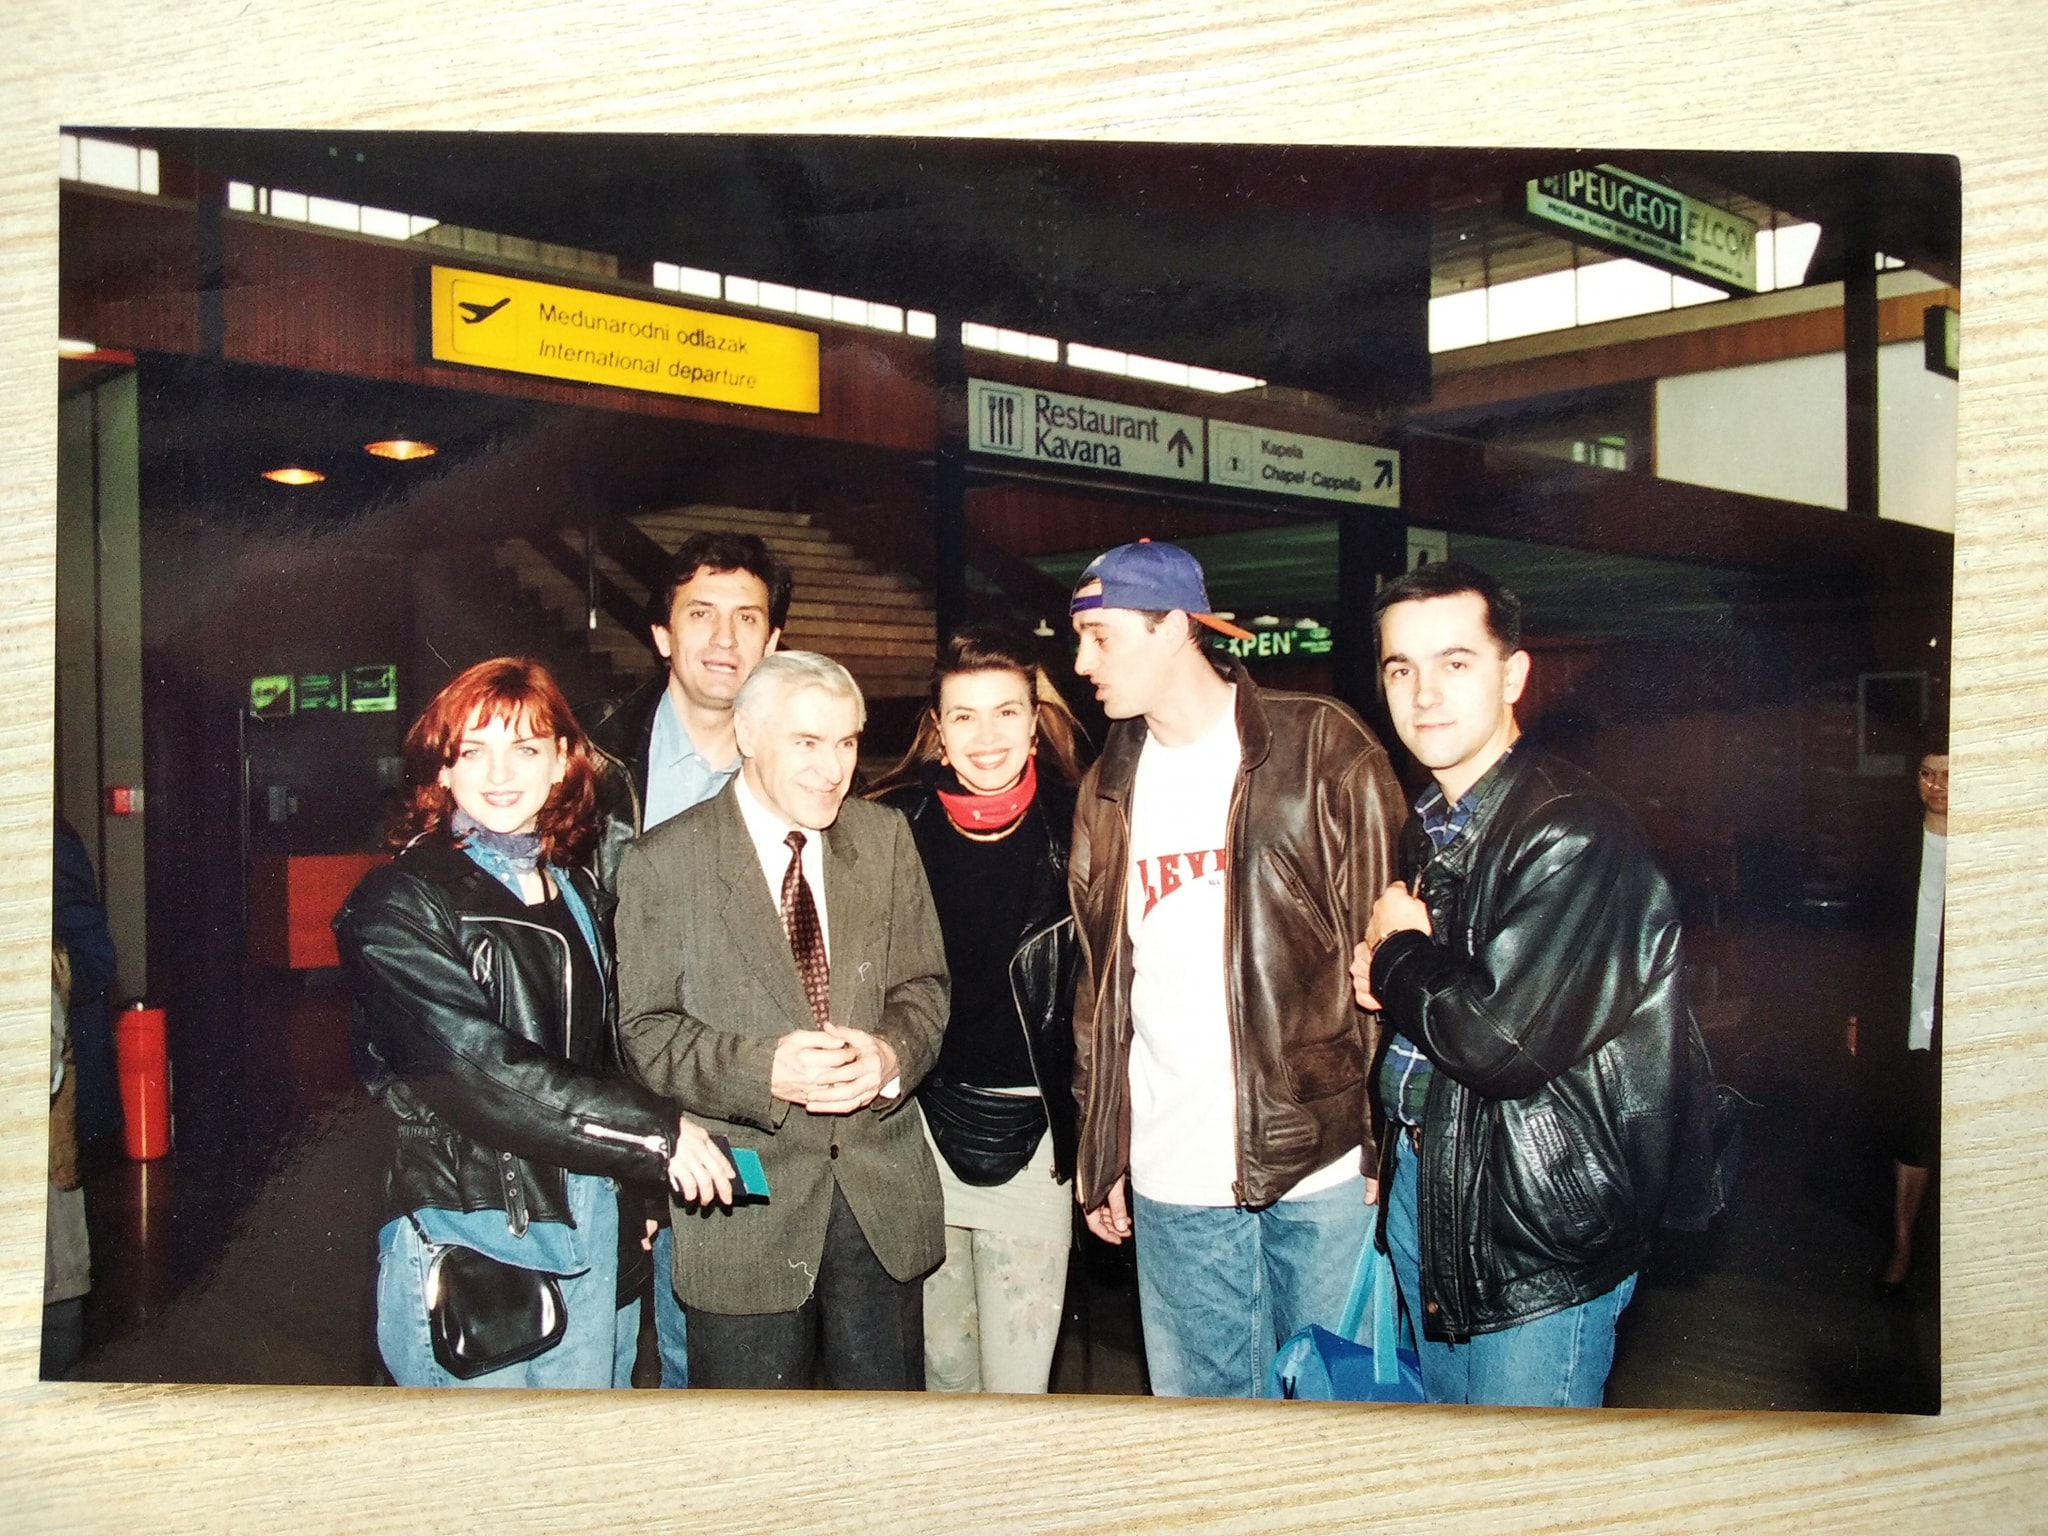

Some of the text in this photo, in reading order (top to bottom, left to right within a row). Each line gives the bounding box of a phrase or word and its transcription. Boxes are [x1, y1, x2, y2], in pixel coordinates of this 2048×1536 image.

[1568, 168, 1679, 236] PEUGEOT
[676, 328, 749, 354] odlazak
[539, 339, 757, 389] International departure
[1035, 394, 1159, 443] Restaurant
[1035, 426, 1121, 467] Kavana
[1261, 439, 1304, 460] Kapela
